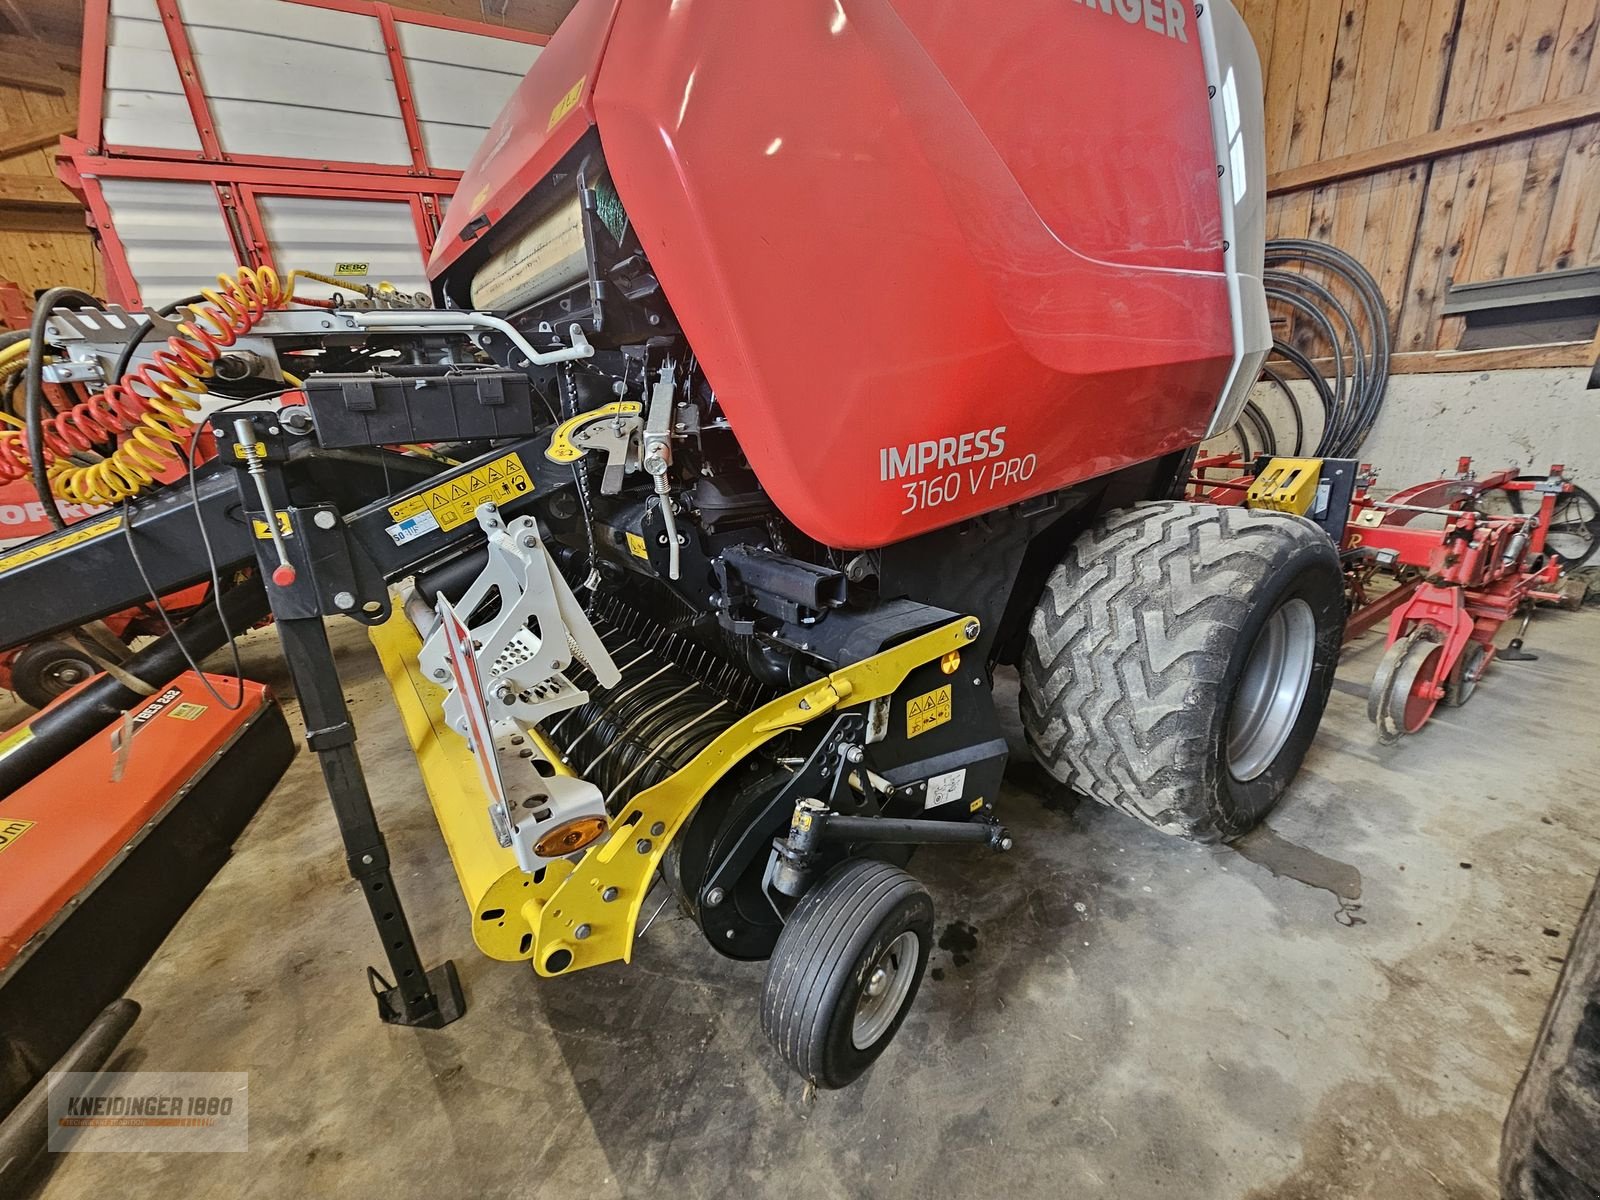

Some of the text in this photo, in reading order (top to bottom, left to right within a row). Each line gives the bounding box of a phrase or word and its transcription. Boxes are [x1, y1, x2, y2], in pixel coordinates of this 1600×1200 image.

[880, 426, 1006, 481] IMPRESS
[902, 453, 1037, 515] 3160 V PRO
[157, 690, 181, 704] 262
